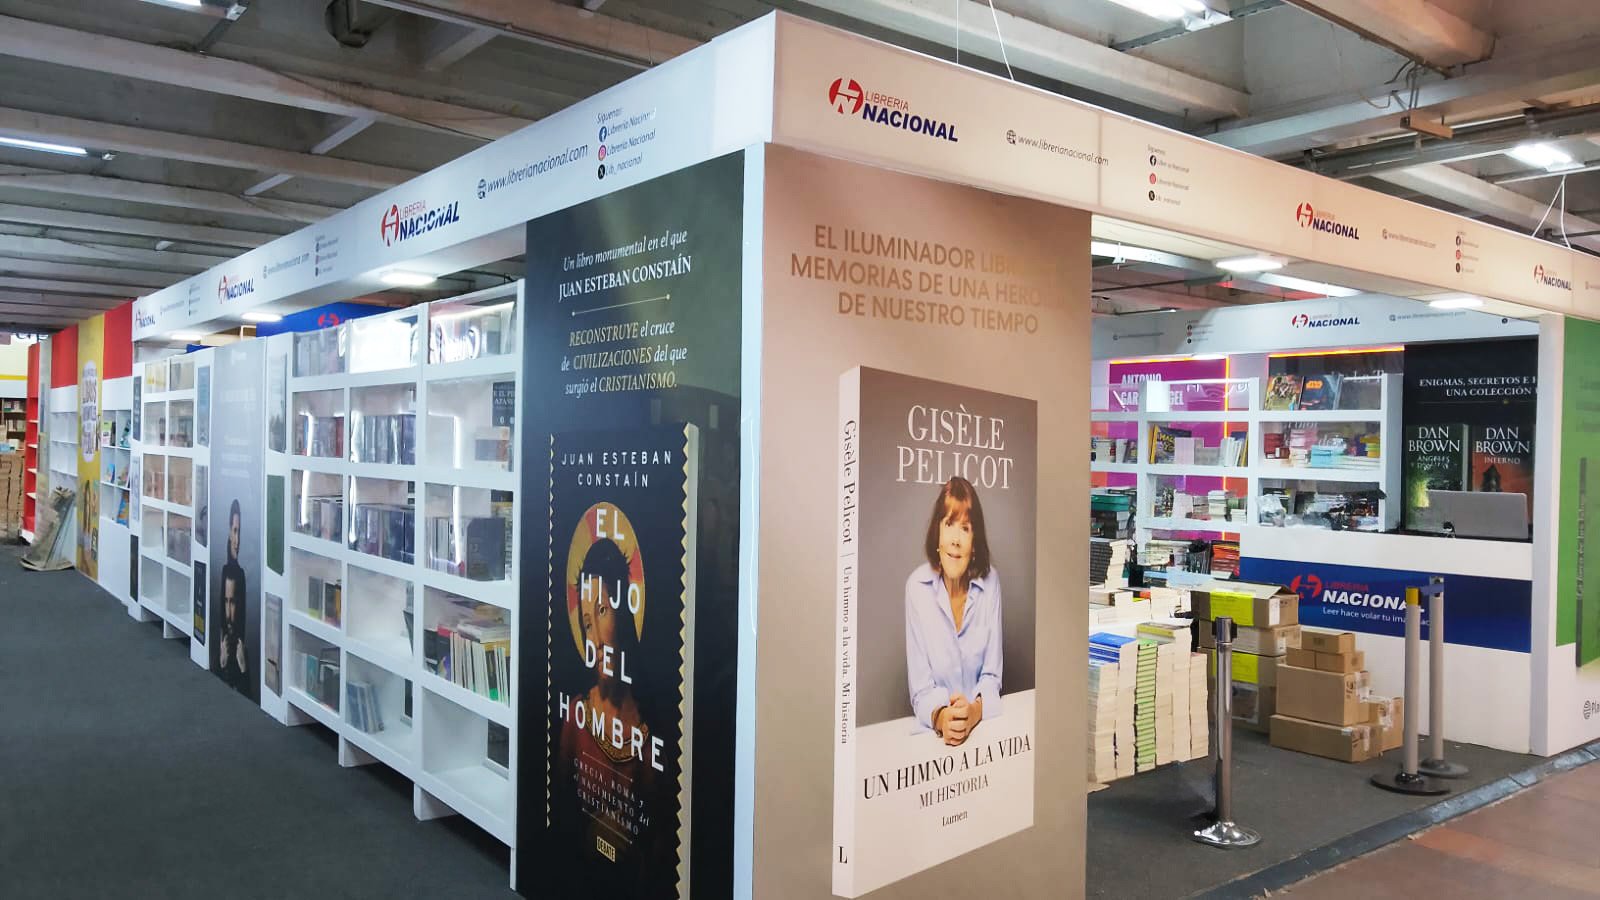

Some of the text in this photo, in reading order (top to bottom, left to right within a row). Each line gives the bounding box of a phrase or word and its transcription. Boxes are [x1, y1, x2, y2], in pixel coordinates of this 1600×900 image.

[865, 90, 909, 112] LIBRERIA
[862, 103, 959, 143] NACIONAL
[1017, 135, 1110, 167] www.librerianacional.com
[487, 144, 588, 192] www.librerianacional.com
[400, 201, 460, 242] NACIONAL
[1312, 217, 1360, 240] NACIONAL
[563, 230, 688, 272] Un libro monumental en el que
[815, 224, 837, 249] EL
[844, 229, 976, 270] ILUMINADOR
[226, 278, 255, 300] NACIONAL
[558, 253, 692, 302] JUAN ESTEBAN CONSTAÍN
[791, 252, 913, 291] MEMORIAS
[919, 271, 943, 294] DE
[949, 275, 990, 301] UNA
[1543, 275, 1572, 291] NACIONAL
[838, 291, 1039, 335] DE NUESTRO TIEMPO
[1308, 316, 1361, 328] NACIONAL
[569, 320, 675, 347] RECONSTRUYE el cruce
[561, 344, 688, 372] de CIVILIZACIONES del que
[565, 371, 678, 399] surgió el CRISTIANISMO.
[1419, 376, 1466, 388] ENIGMAS,
[1468, 375, 1521, 386] SECRETOS
[1523, 375, 1530, 384] E
[1446, 388, 1468, 397] UNA
[1469, 386, 1532, 397] COLECCIÓN
[907, 403, 1005, 451] GISÈLE
[1418, 425, 1449, 439] DAN
[1486, 426, 1519, 440] DAN
[561, 450, 672, 465] JUAN ESTEBAN
[843, 419, 857, 477] Gisèle
[1408, 439, 1460, 455] BROWN
[1475, 440, 1530, 456] BROWN
[577, 471, 649, 488] CONSTAÍN
[896, 445, 1014, 489] PELICOT
[596, 508, 625, 541] EL
[842, 481, 856, 545] Pelicot
[843, 566, 852, 584] Un
[580, 571, 641, 615] HIJO
[842, 586, 852, 623] himno
[1322, 589, 1425, 613] NACIONA
[1322, 606, 1340, 616] Leer
[1340, 607, 1360, 618] hace
[1361, 609, 1381, 621] volar
[1382, 614, 1391, 622] tu
[842, 625, 849, 633] a
[842, 636, 851, 647] la
[585, 639, 633, 685] DEL
[841, 682, 851, 698] Mi
[559, 691, 665, 772] HOMBRE
[841, 701, 850, 745] historia
[863, 733, 1032, 800] UN HIMNO A LA VIDA
[581, 778, 634, 817] NACIMIENTO
[611, 779, 636, 802] ROMA
[919, 774, 989, 810] MI HISTORIA
[577, 789, 639, 836] CRISTIANISMO
[941, 809, 968, 828] Lumen
[838, 846, 848, 864] L
